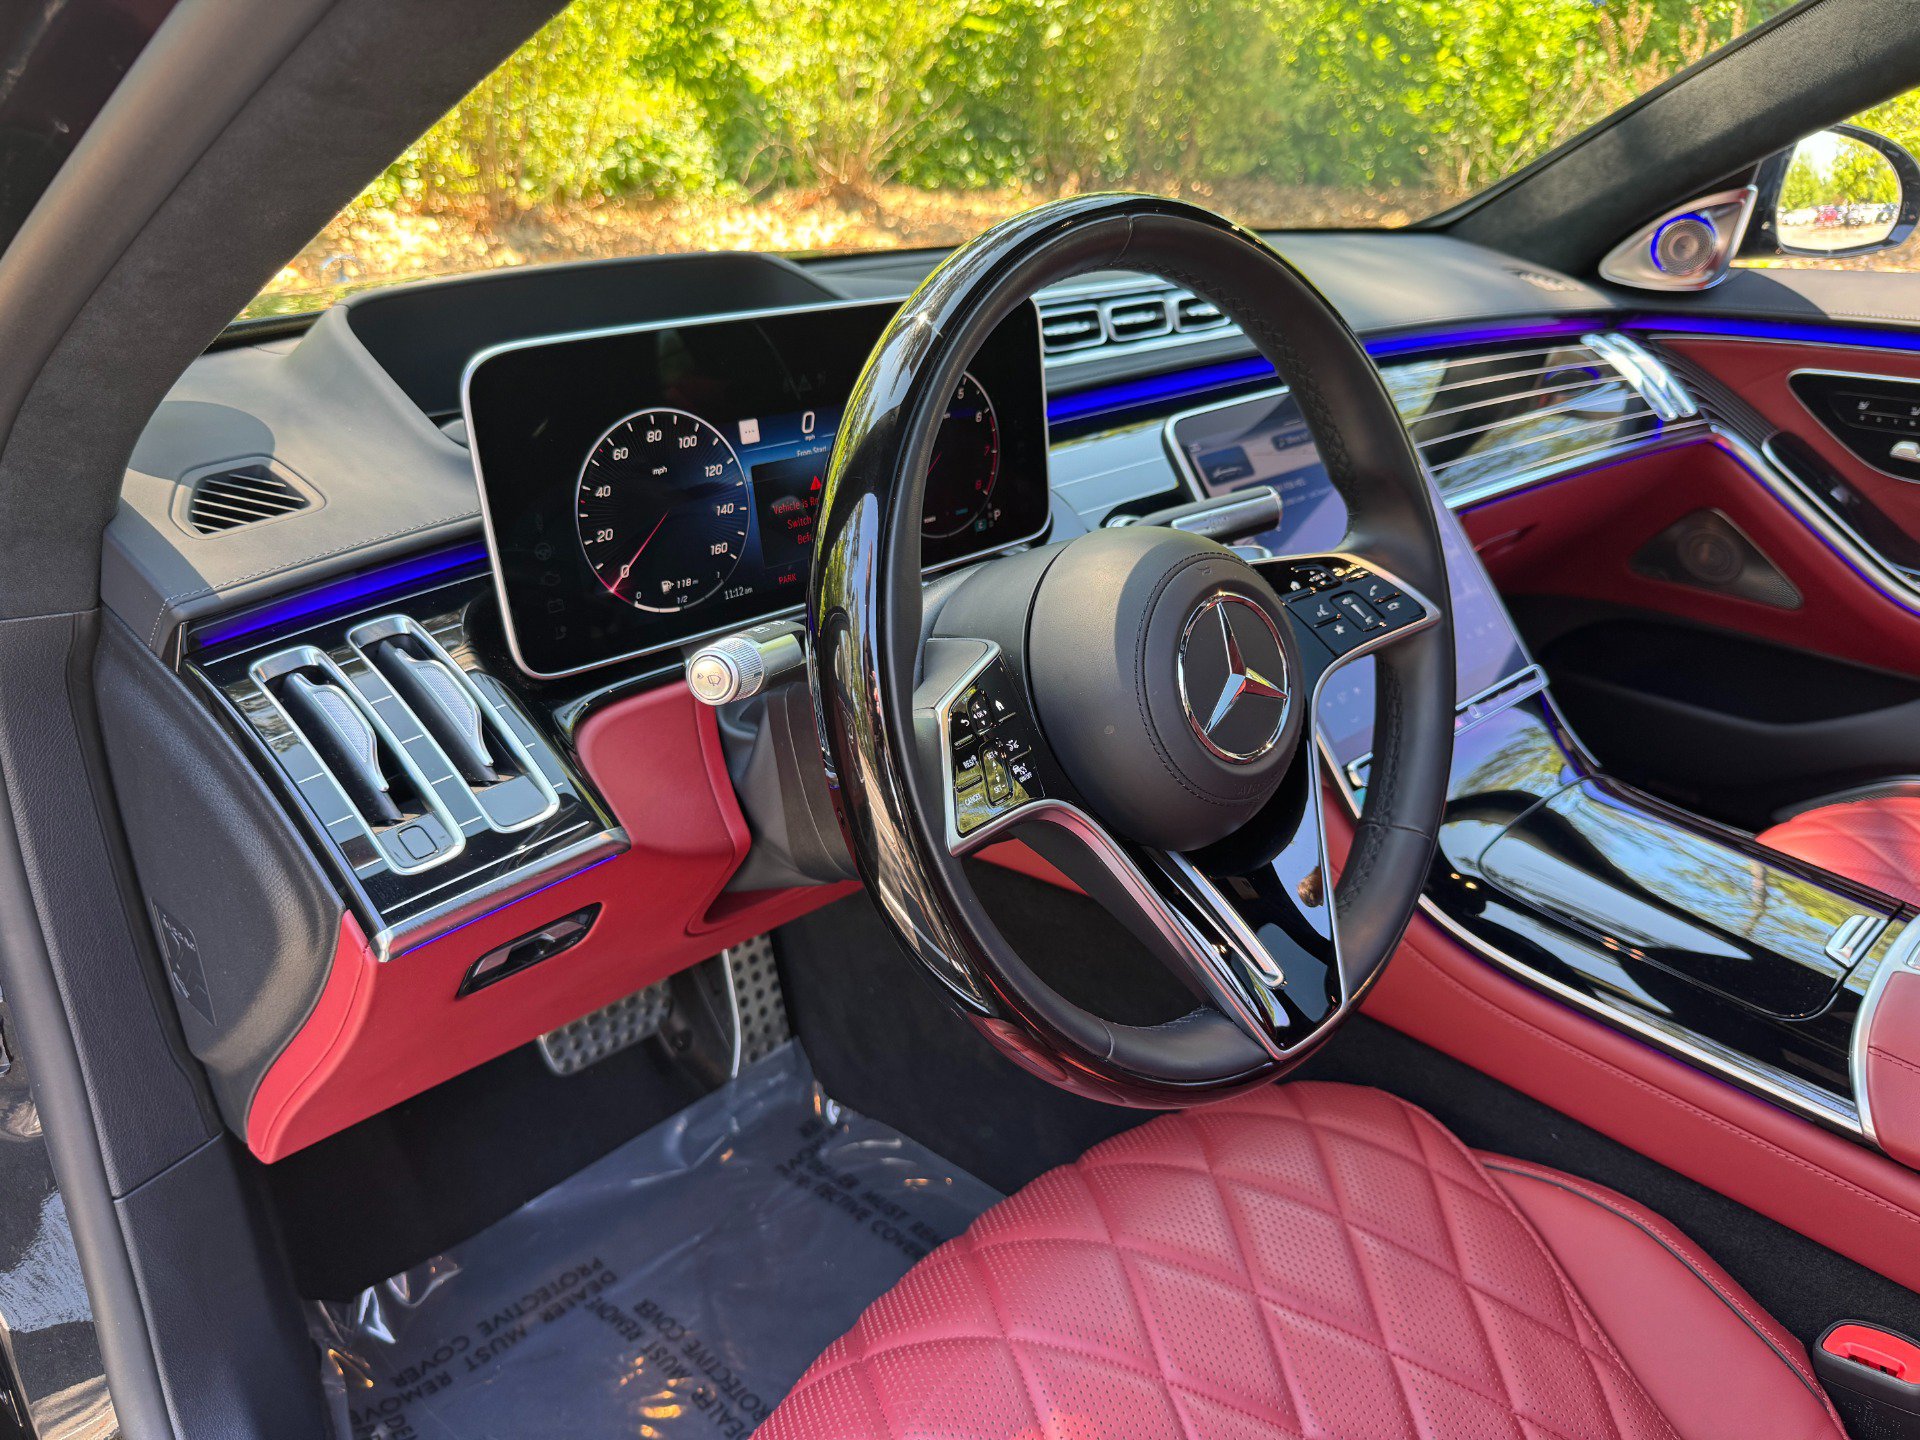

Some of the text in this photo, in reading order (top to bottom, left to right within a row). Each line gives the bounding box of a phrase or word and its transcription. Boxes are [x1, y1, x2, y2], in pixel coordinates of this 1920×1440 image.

[957, 387, 965, 399] 5
[801, 410, 816, 434] 0
[975, 411, 983, 423] 6
[646, 429, 663, 443] 80
[678, 434, 698, 449] 100
[612, 446, 629, 461] 60
[796, 445, 827, 458] From Start
[984, 444, 991, 456] 7
[651, 465, 668, 476] mph
[704, 463, 723, 478] 120
[594, 484, 612, 498] 40
[716, 502, 735, 516] 140
[772, 500, 801, 515] Vehicle
[801, 498, 809, 509] is
[993, 508, 1001, 521] P
[787, 515, 812, 530] Switch
[596, 528, 614, 543] 20
[797, 531, 812, 545] Bef
[710, 541, 728, 556] 160
[620, 564, 630, 579] 0
[676, 578, 691, 589] 118
[778, 573, 797, 585] PARK
[676, 595, 688, 604] 1/2
[964, 793, 983, 807] CANCEL
[540, 1267, 618, 1324] DEALER
[390, 1255, 606, 1389] PROTECTIVE COVER
[464, 1323, 529, 1373] MUST
